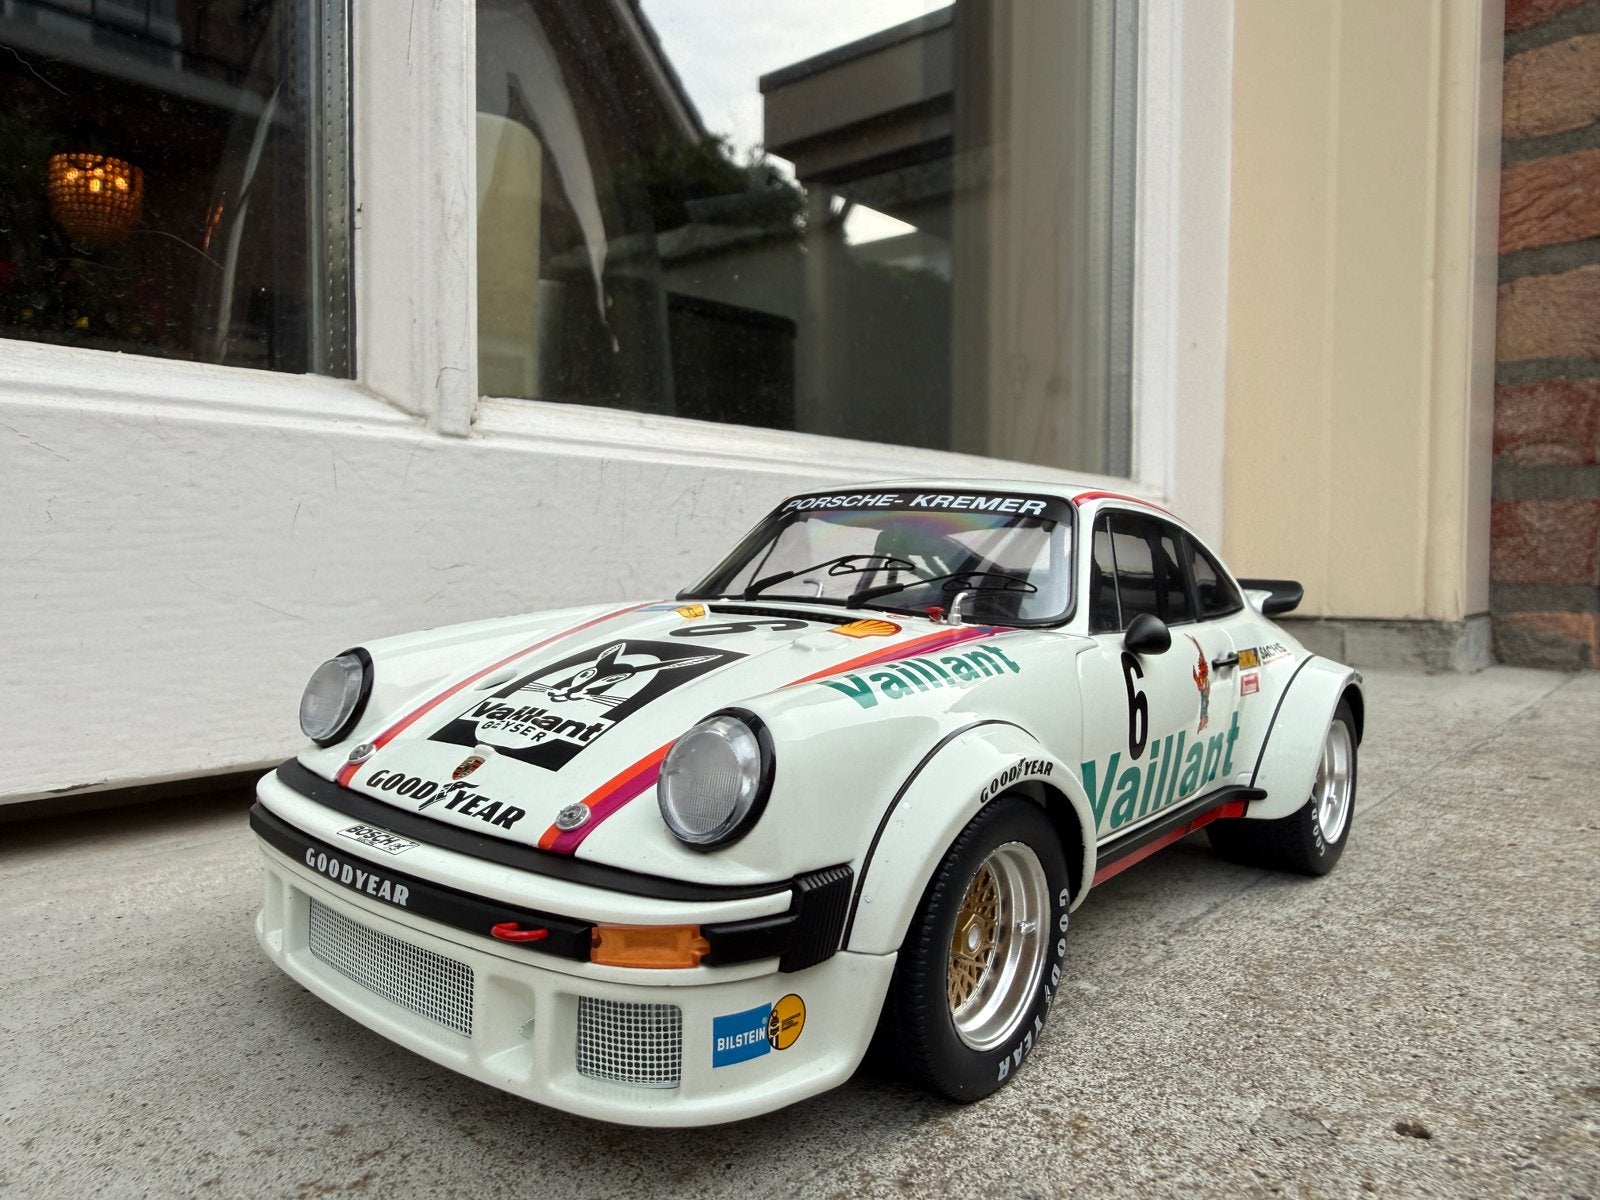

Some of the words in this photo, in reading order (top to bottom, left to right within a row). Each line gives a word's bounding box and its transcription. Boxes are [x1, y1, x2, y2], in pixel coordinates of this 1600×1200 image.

[909, 494, 1047, 516] KREMER
[1258, 642, 1287, 660] SACHS
[817, 644, 1021, 710] Vaillant
[471, 701, 605, 742] Vaillant
[1121, 651, 1149, 761] 6
[481, 720, 547, 742] GEYSER
[1080, 711, 1240, 834] Vaillant
[345, 825, 401, 846] BOSCH
[305, 847, 411, 907] GOODYEAR
[717, 1026, 766, 1052] BILSTEIN
